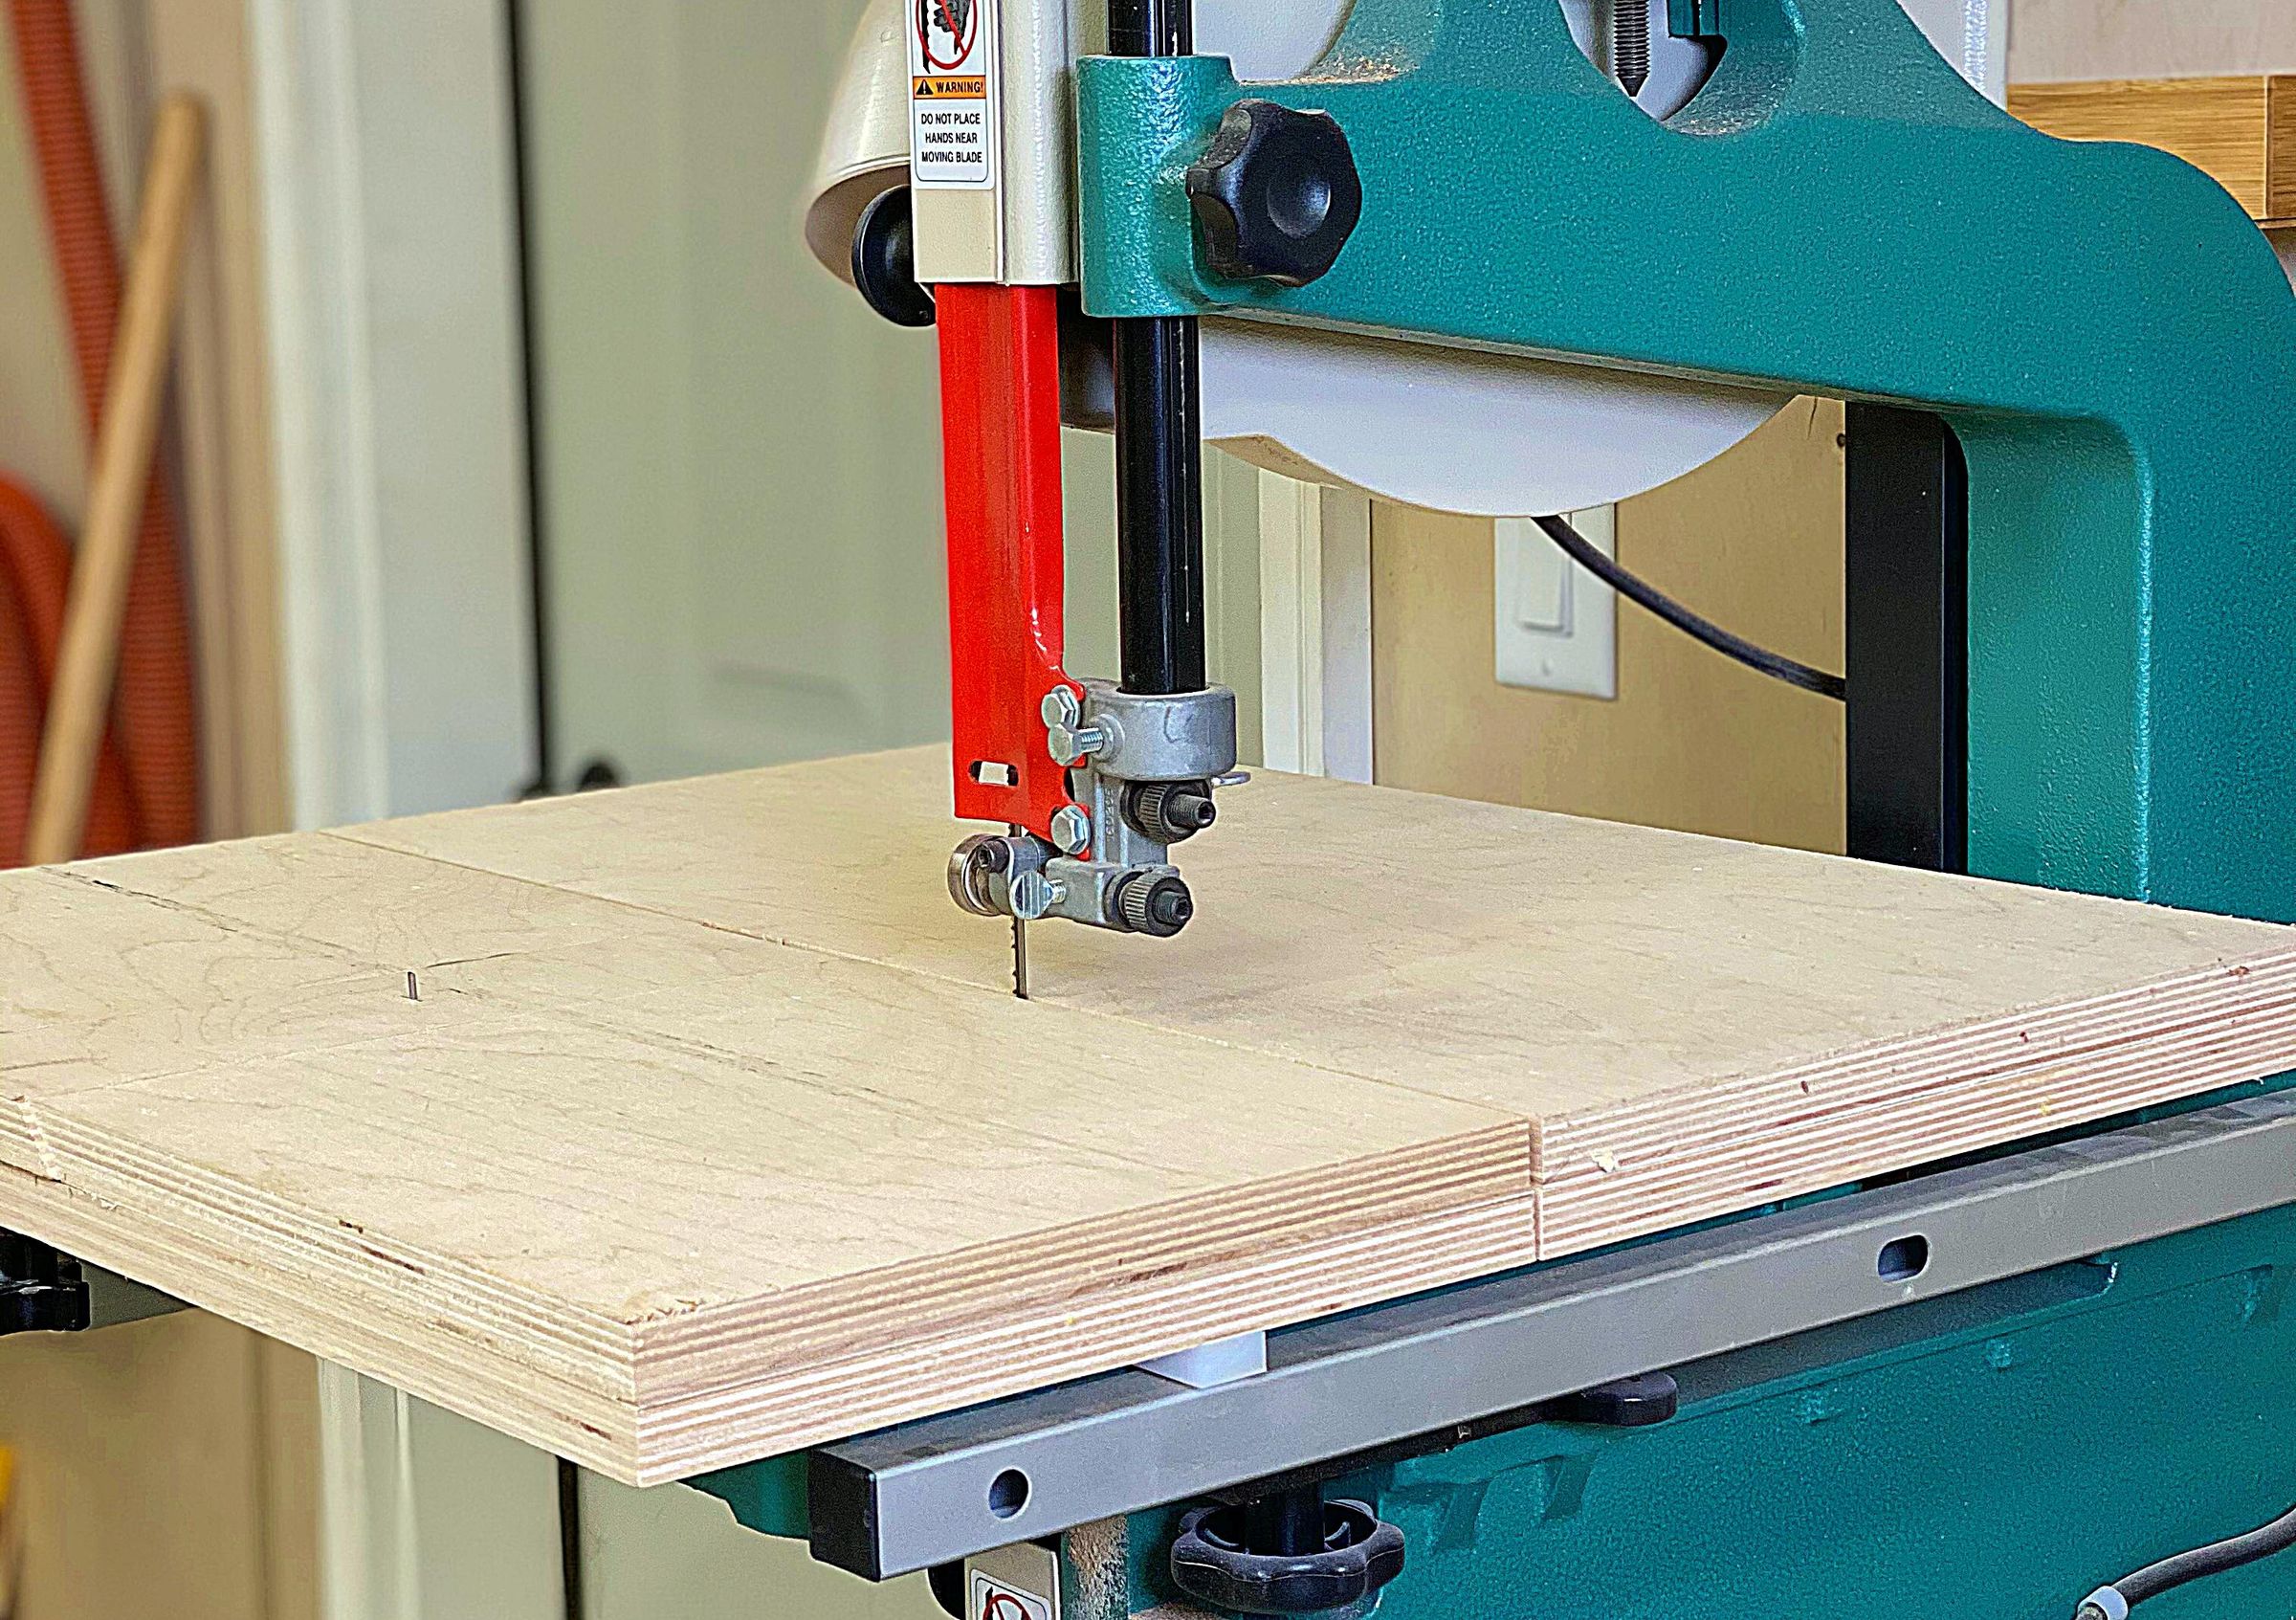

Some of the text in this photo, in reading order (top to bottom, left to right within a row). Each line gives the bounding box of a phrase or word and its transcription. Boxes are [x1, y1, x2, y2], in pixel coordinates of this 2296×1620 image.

[936, 81, 983, 93] WARNING!
[921, 113, 981, 124] DO NOT PLACE
[925, 132, 978, 144] HANDS NEAR
[921, 151, 982, 163] MOVING BLADE
